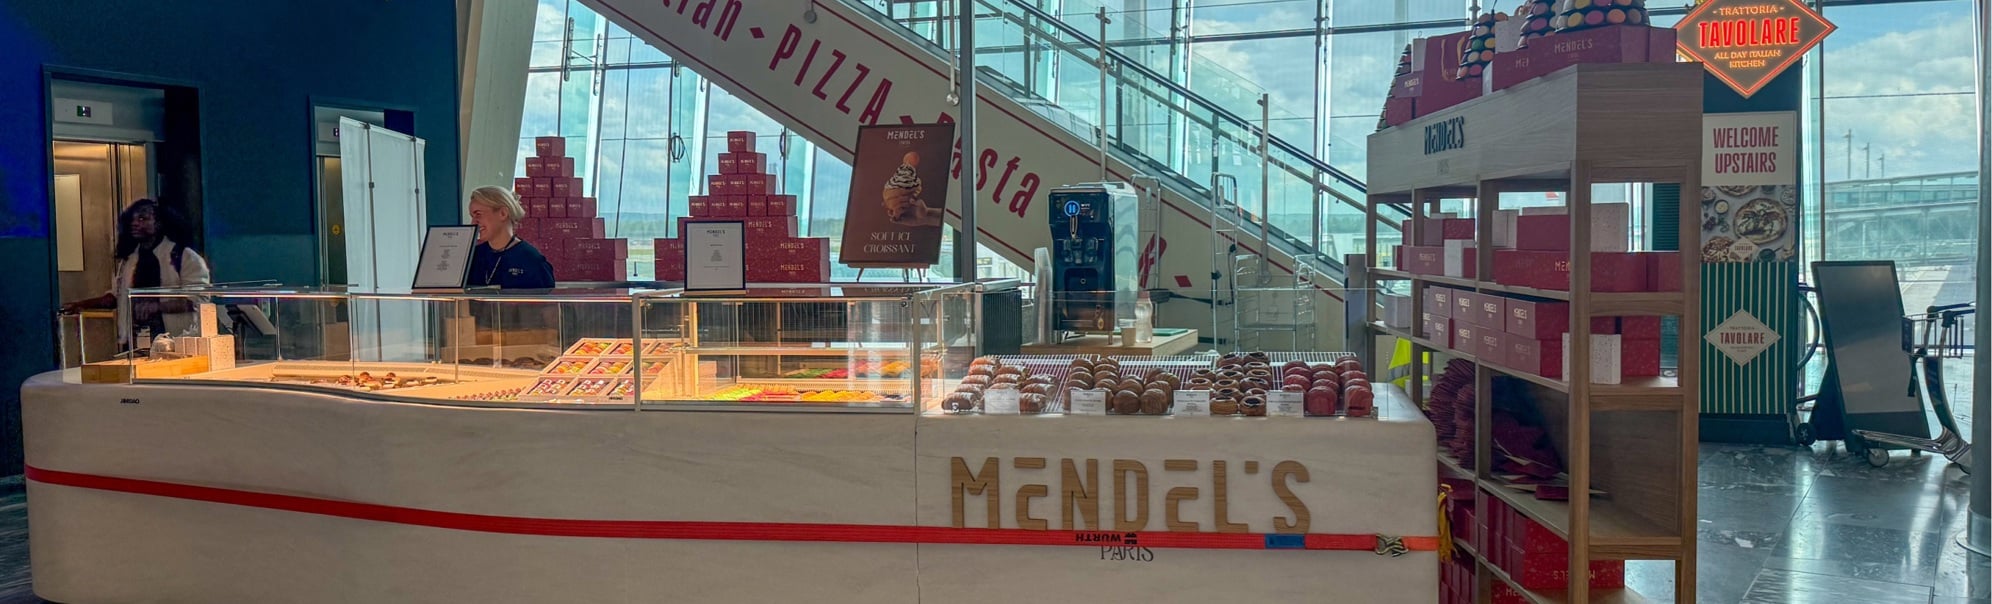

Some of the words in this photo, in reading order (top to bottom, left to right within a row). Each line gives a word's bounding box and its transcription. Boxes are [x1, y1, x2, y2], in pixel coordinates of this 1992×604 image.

[1719, 5, 1778, 16] TRATTORIA
[1698, 17, 1800, 48] TAVOLARE
[1714, 51, 1729, 60] ALL
[1730, 51, 1748, 59] DAY
[1749, 49, 1781, 58] ITALIAN
[1729, 59, 1766, 69] KITCHEN
[768, 23, 893, 126] PIZZA
[887, 130, 926, 141] MENDEL'S
[1424, 116, 1465, 155] MENDEL'S
[1713, 126, 1779, 148] WELCOME
[1715, 152, 1777, 173] UPSTAIRS
[863, 243, 915, 254] CROISSANT
[1720, 332, 1765, 345] TAVOLARE
[950, 456, 1311, 534] MENDEL'S
[1100, 545, 1154, 562] PARIS
